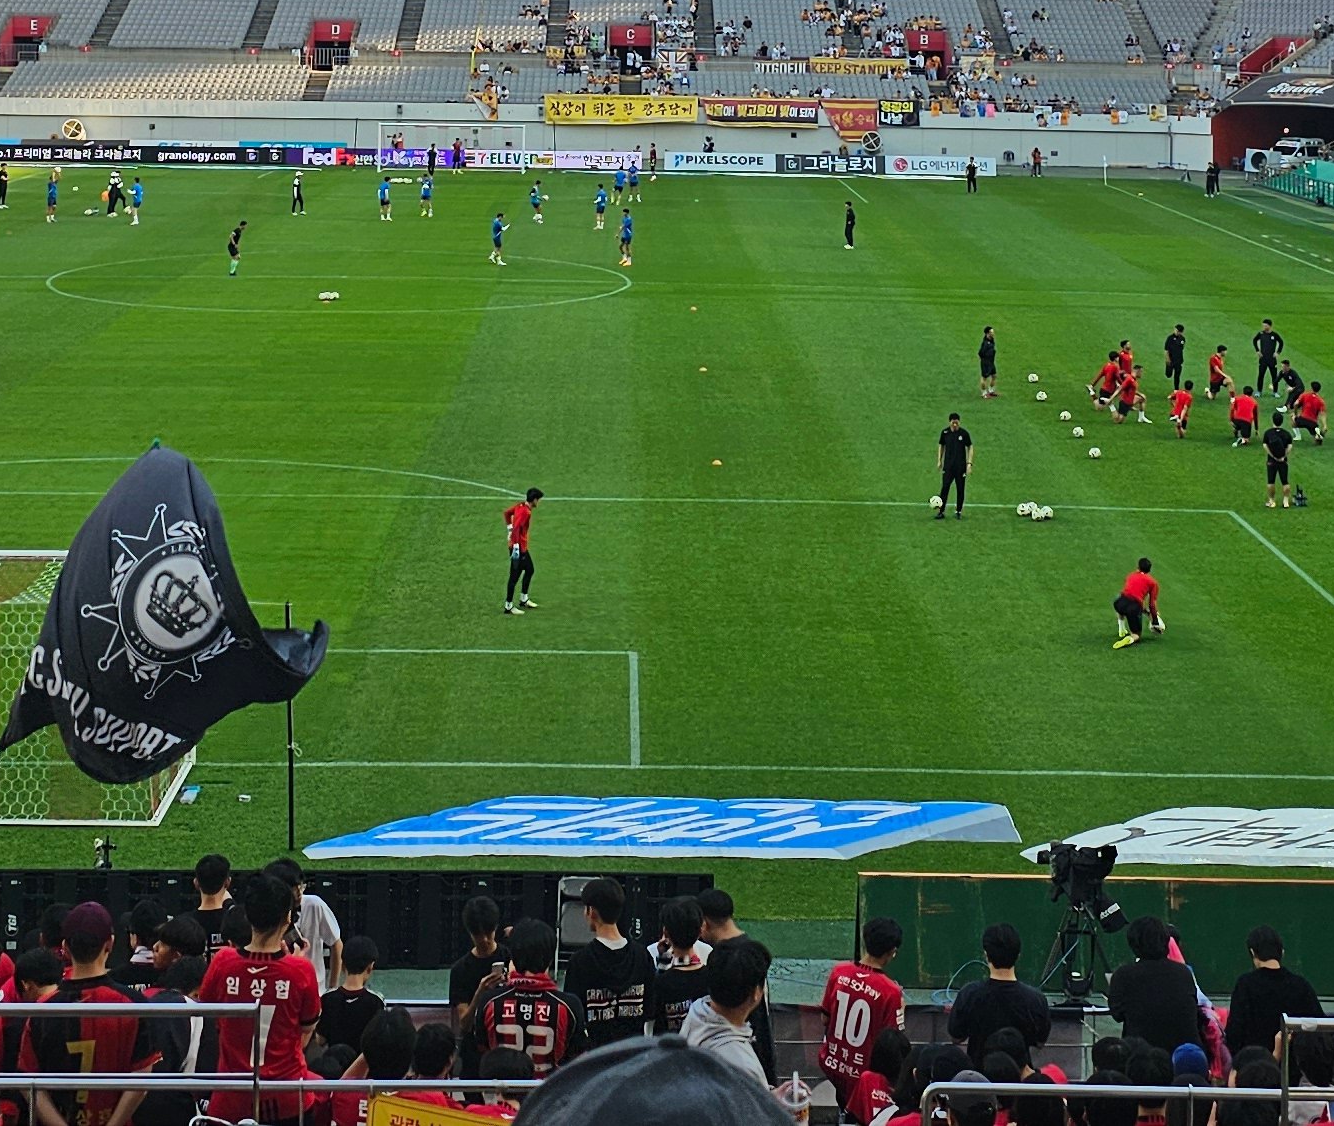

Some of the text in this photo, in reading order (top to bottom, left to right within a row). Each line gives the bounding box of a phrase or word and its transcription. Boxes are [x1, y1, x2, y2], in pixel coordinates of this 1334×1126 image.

[30, 19, 38, 30] E
[331, 24, 340, 35] D
[626, 28, 635, 39] C
[920, 34, 929, 45] B
[1287, 42, 1296, 53] A
[810, 61, 842, 76] KEEP
[549, 101, 586, 117] 심장이
[623, 103, 635, 116] 한
[642, 104, 693, 117] 광주답게
[13, 148, 52, 160] 프리미엄
[94, 148, 142, 161] 그라놀로지
[157, 151, 237, 164] granology.com
[686, 154, 764, 166] PIXELSCOPE
[803, 155, 877, 174] 그라놀로지
[911, 160, 928, 172] LG
[501, 1002, 552, 1024] 고명진
[833, 989, 871, 1048] 10
[824, 1055, 839, 1071] GS
